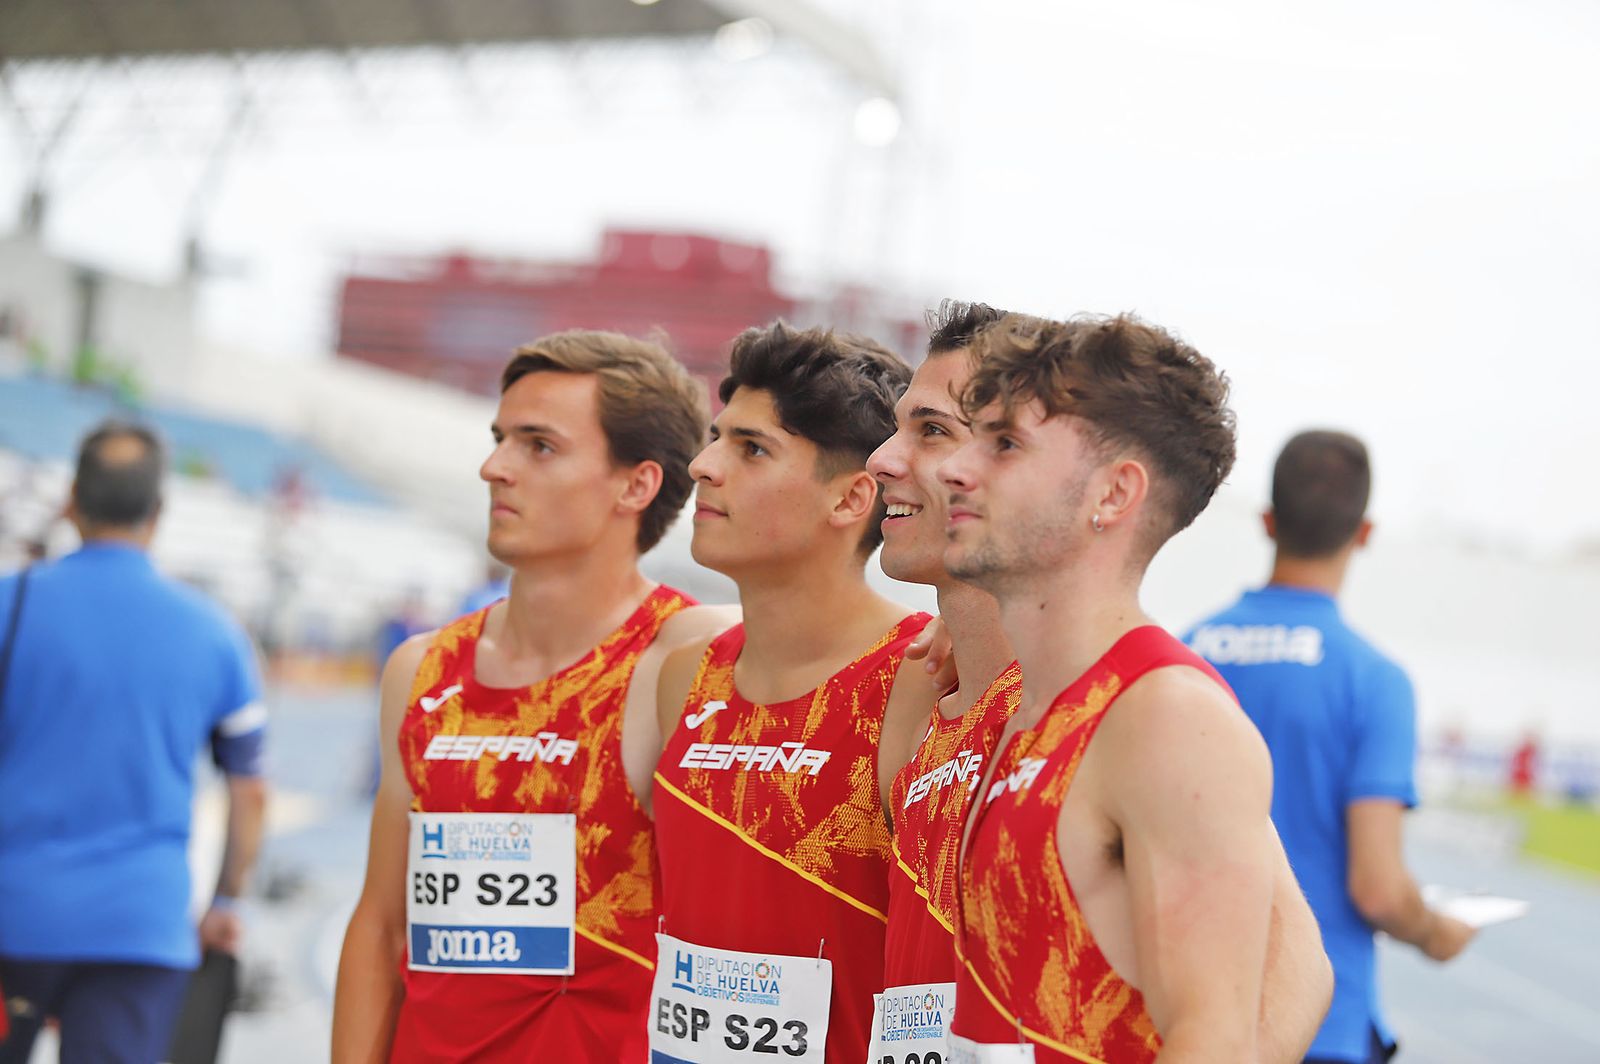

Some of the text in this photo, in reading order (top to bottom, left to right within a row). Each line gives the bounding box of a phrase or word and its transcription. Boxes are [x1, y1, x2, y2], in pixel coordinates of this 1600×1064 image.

[423, 732, 579, 766] ESPAÑA
[679, 741, 832, 776] ESPAÑA
[903, 750, 983, 809] ESPAÑA
[469, 838, 531, 850] HUELVA
[415, 873, 558, 907] ESP S23
[697, 955, 782, 979] DIPUTACIÓN
[696, 970, 780, 994] DE HUELVA
[696, 986, 745, 1002] OBJETIVOS
[657, 997, 808, 1057] ESP S23
[886, 1010, 942, 1030] DE HUELVA
[886, 1028, 917, 1042] OBJETIVOS
